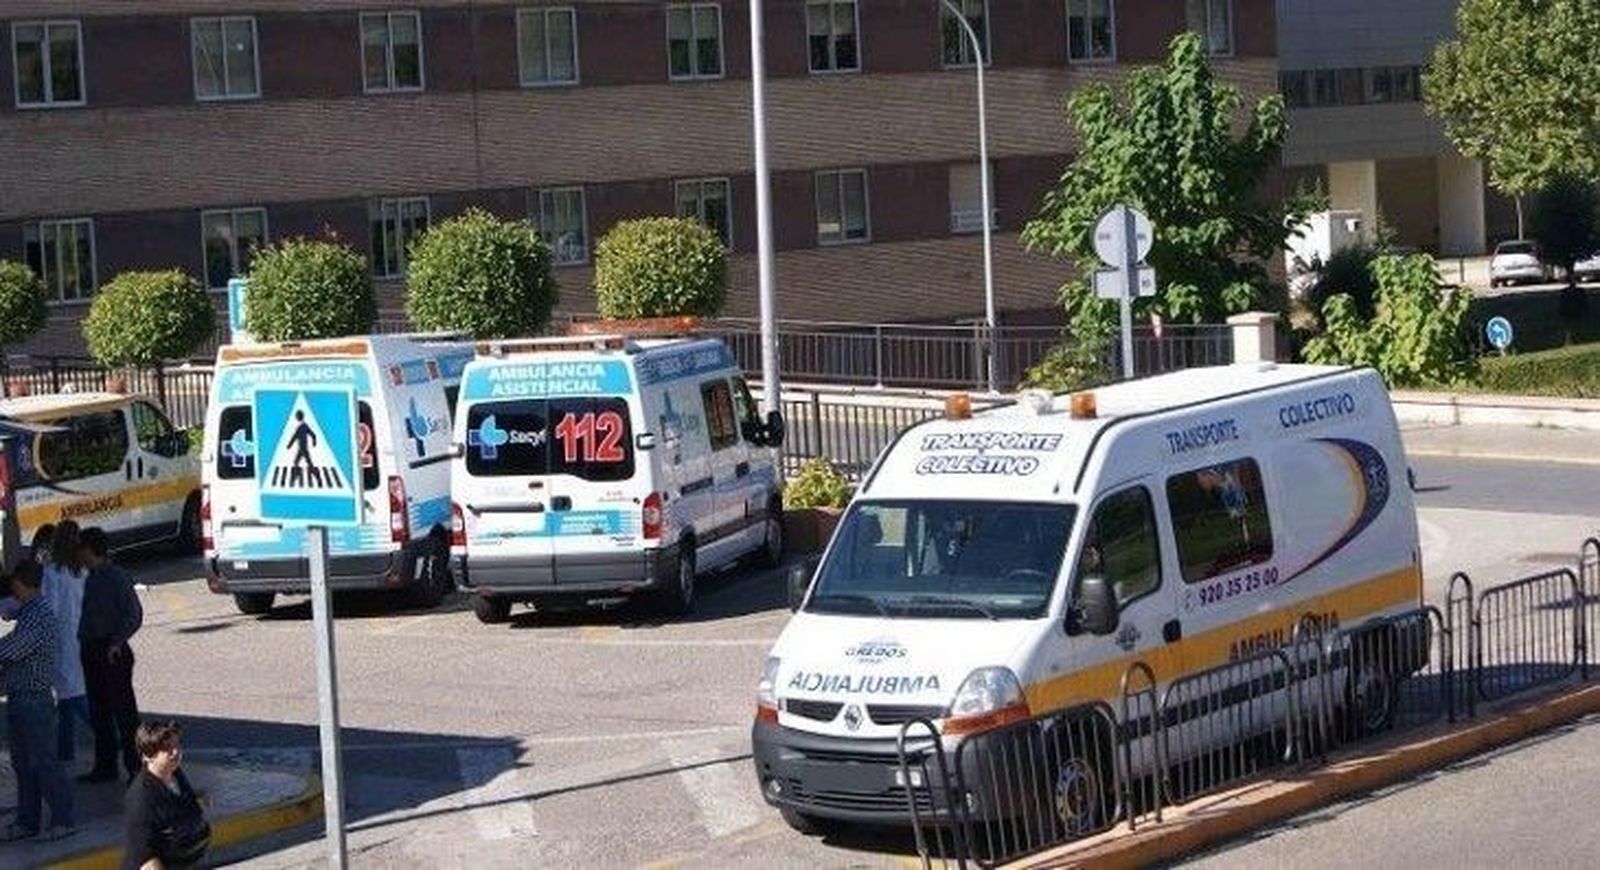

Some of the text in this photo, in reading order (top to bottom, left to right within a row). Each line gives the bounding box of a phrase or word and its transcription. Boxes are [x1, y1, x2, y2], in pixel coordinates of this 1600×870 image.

[488, 363, 605, 381] AMBULANCIA
[491, 379, 602, 397] ASISTENCIAL
[1165, 393, 1355, 454] TRANSPORTE COLECTIVO
[555, 411, 625, 463] 112
[920, 432, 1063, 452] TRANSPORTE
[915, 454, 1040, 476] COLECTIVO
[1199, 582, 1223, 606] 920
[1226, 576, 1243, 597] 35
[1262, 566, 1279, 587] 00
